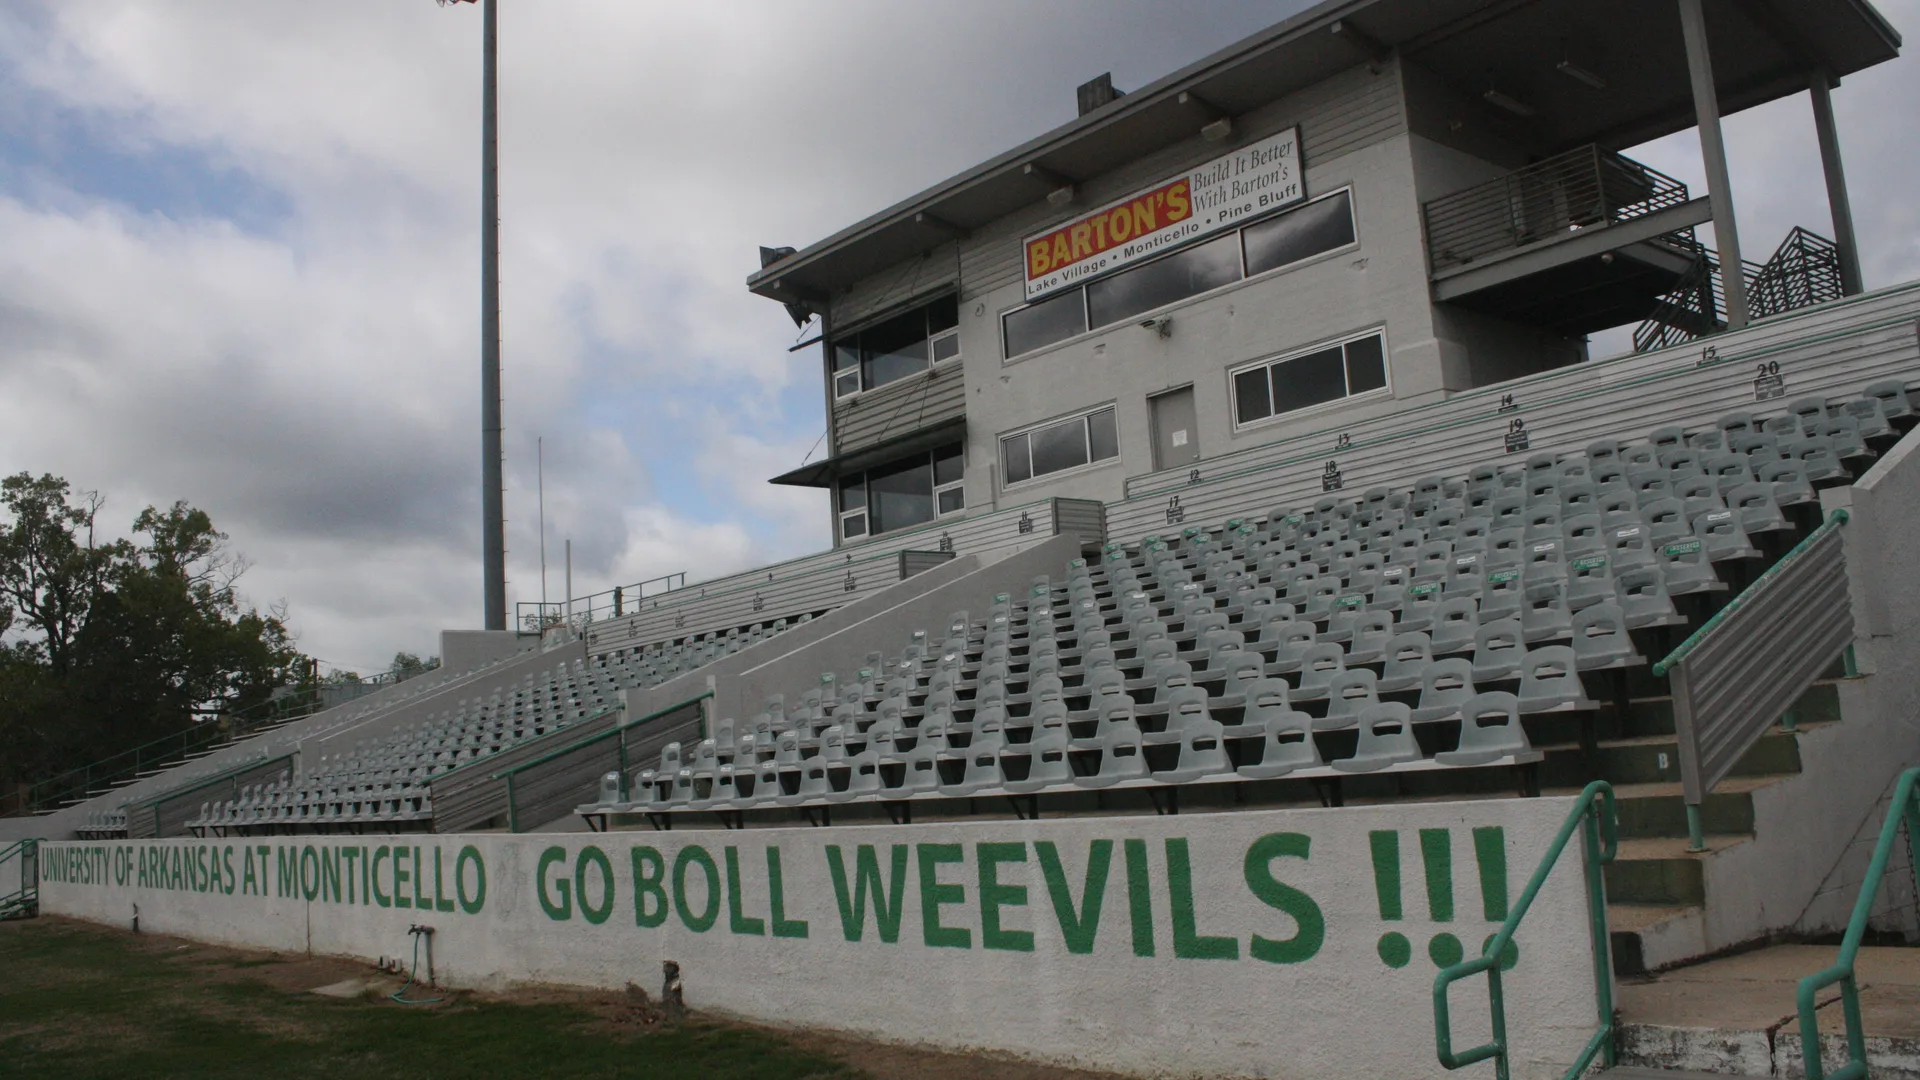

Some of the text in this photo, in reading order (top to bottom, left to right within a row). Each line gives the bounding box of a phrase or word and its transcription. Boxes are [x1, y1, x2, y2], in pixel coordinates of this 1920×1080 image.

[1194, 140, 1293, 192] Build It Better
[1194, 163, 1289, 213] With Barton's
[1028, 183, 1298, 295] Lake Village Monticello Pine Bluff
[1030, 183, 1189, 276] BARTON'S
[1756, 360, 1780, 378] 20
[1508, 418, 1524, 434] 19
[1325, 460, 1337, 475] 18
[1168, 494, 1180, 508] 17
[42, 844, 487, 915] UNIVERSITY OF ARKANSAS AT MONTICELLO
[536, 845, 615, 925] GO
[630, 845, 809, 939] BOLL
[825, 831, 1325, 965] WEEVILS
